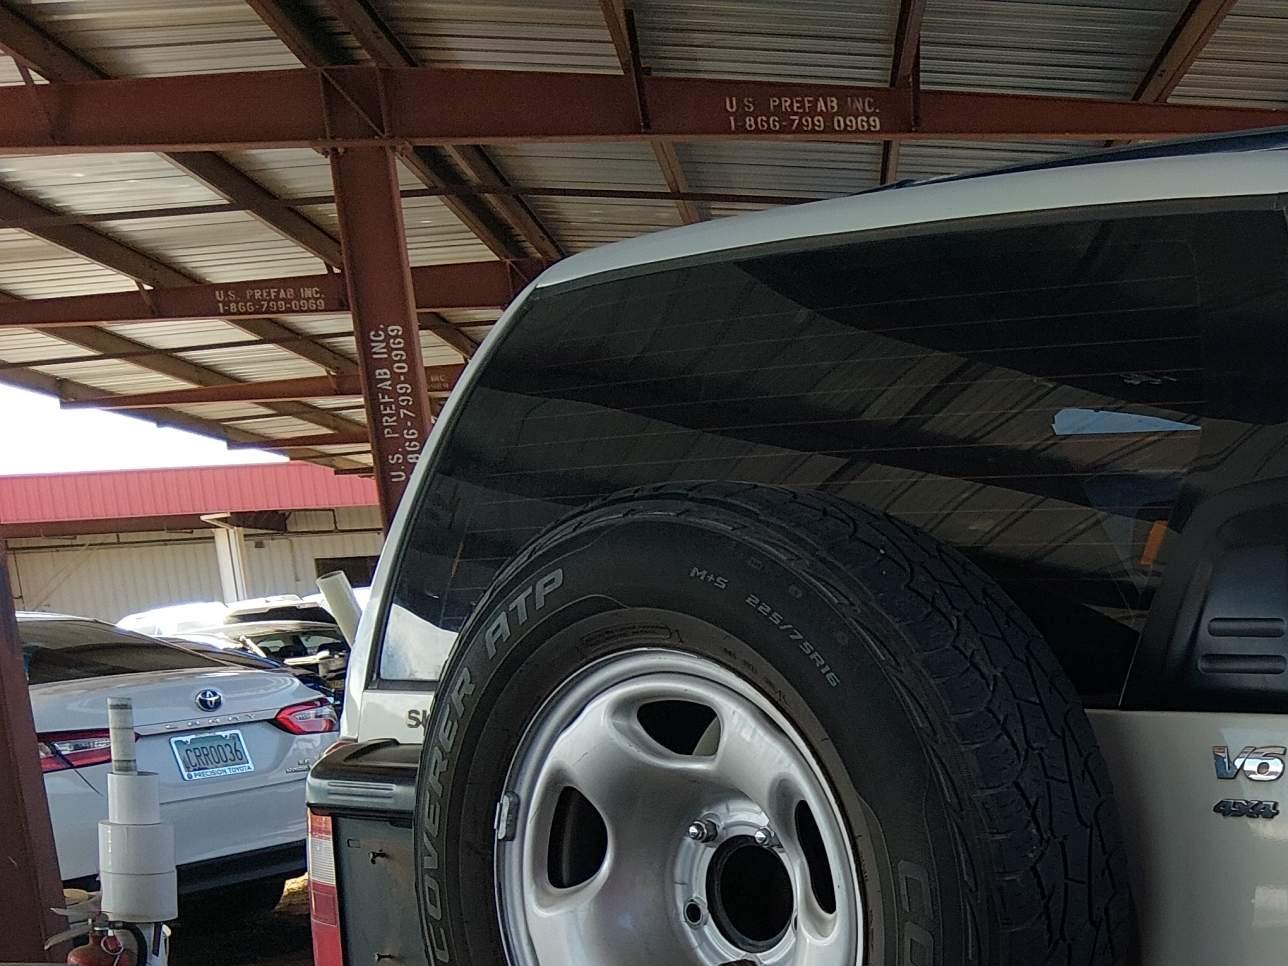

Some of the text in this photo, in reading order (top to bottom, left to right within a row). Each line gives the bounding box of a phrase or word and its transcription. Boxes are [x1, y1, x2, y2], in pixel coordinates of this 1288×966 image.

[769, 96, 838, 113] PREFAB
[218, 299, 325, 314] 1-866-799-0969
[246, 287, 295, 300] PREFAB
[300, 287, 325, 299] INC.
[369, 323, 406, 482] U.S. PREFAB INC.
[387, 325, 422, 464] 866-799-0969
[689, 566, 729, 590] M+S
[484, 567, 565, 660] ATP
[745, 594, 841, 689] 225/75R16
[1212, 745, 1287, 782] V6
